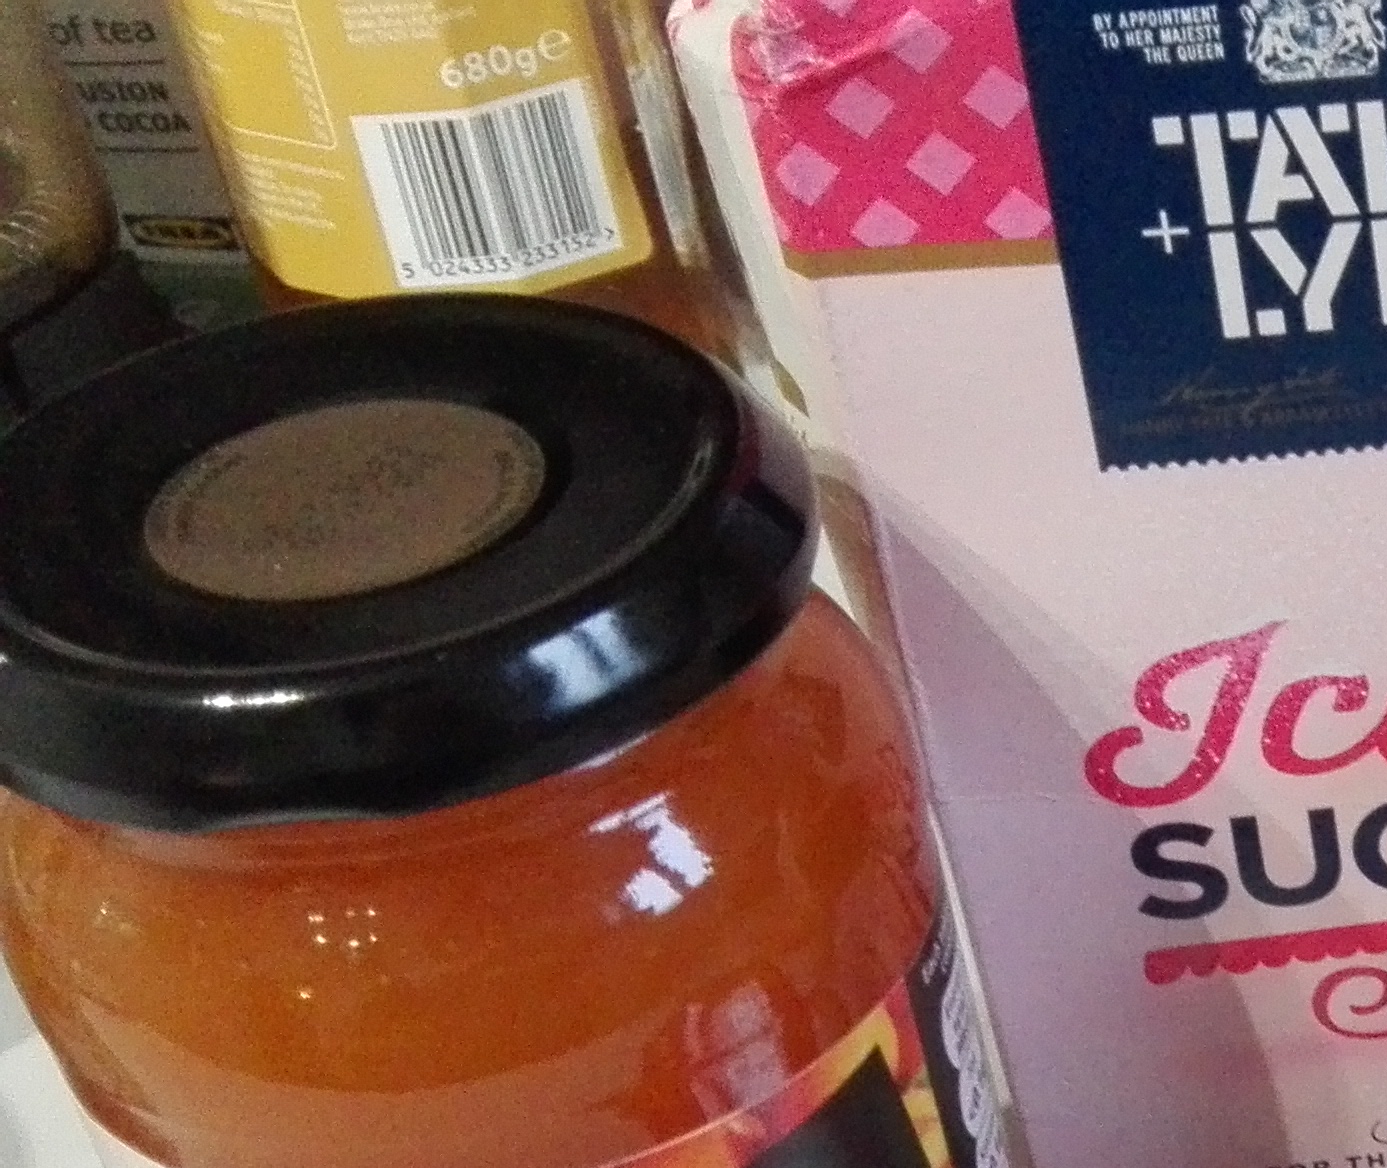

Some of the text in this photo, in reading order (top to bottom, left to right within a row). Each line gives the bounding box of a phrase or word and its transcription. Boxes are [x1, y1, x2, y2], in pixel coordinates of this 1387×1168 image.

[1118, 5, 1218, 29] APPOINTMENT
[92, 18, 157, 45] tea
[1099, 24, 1222, 49] TO HER MAJESTY
[1143, 42, 1225, 64] THE QUEEN
[438, 45, 540, 90] 680g
[76, 80, 170, 102] USION
[97, 111, 193, 134] COCOA
